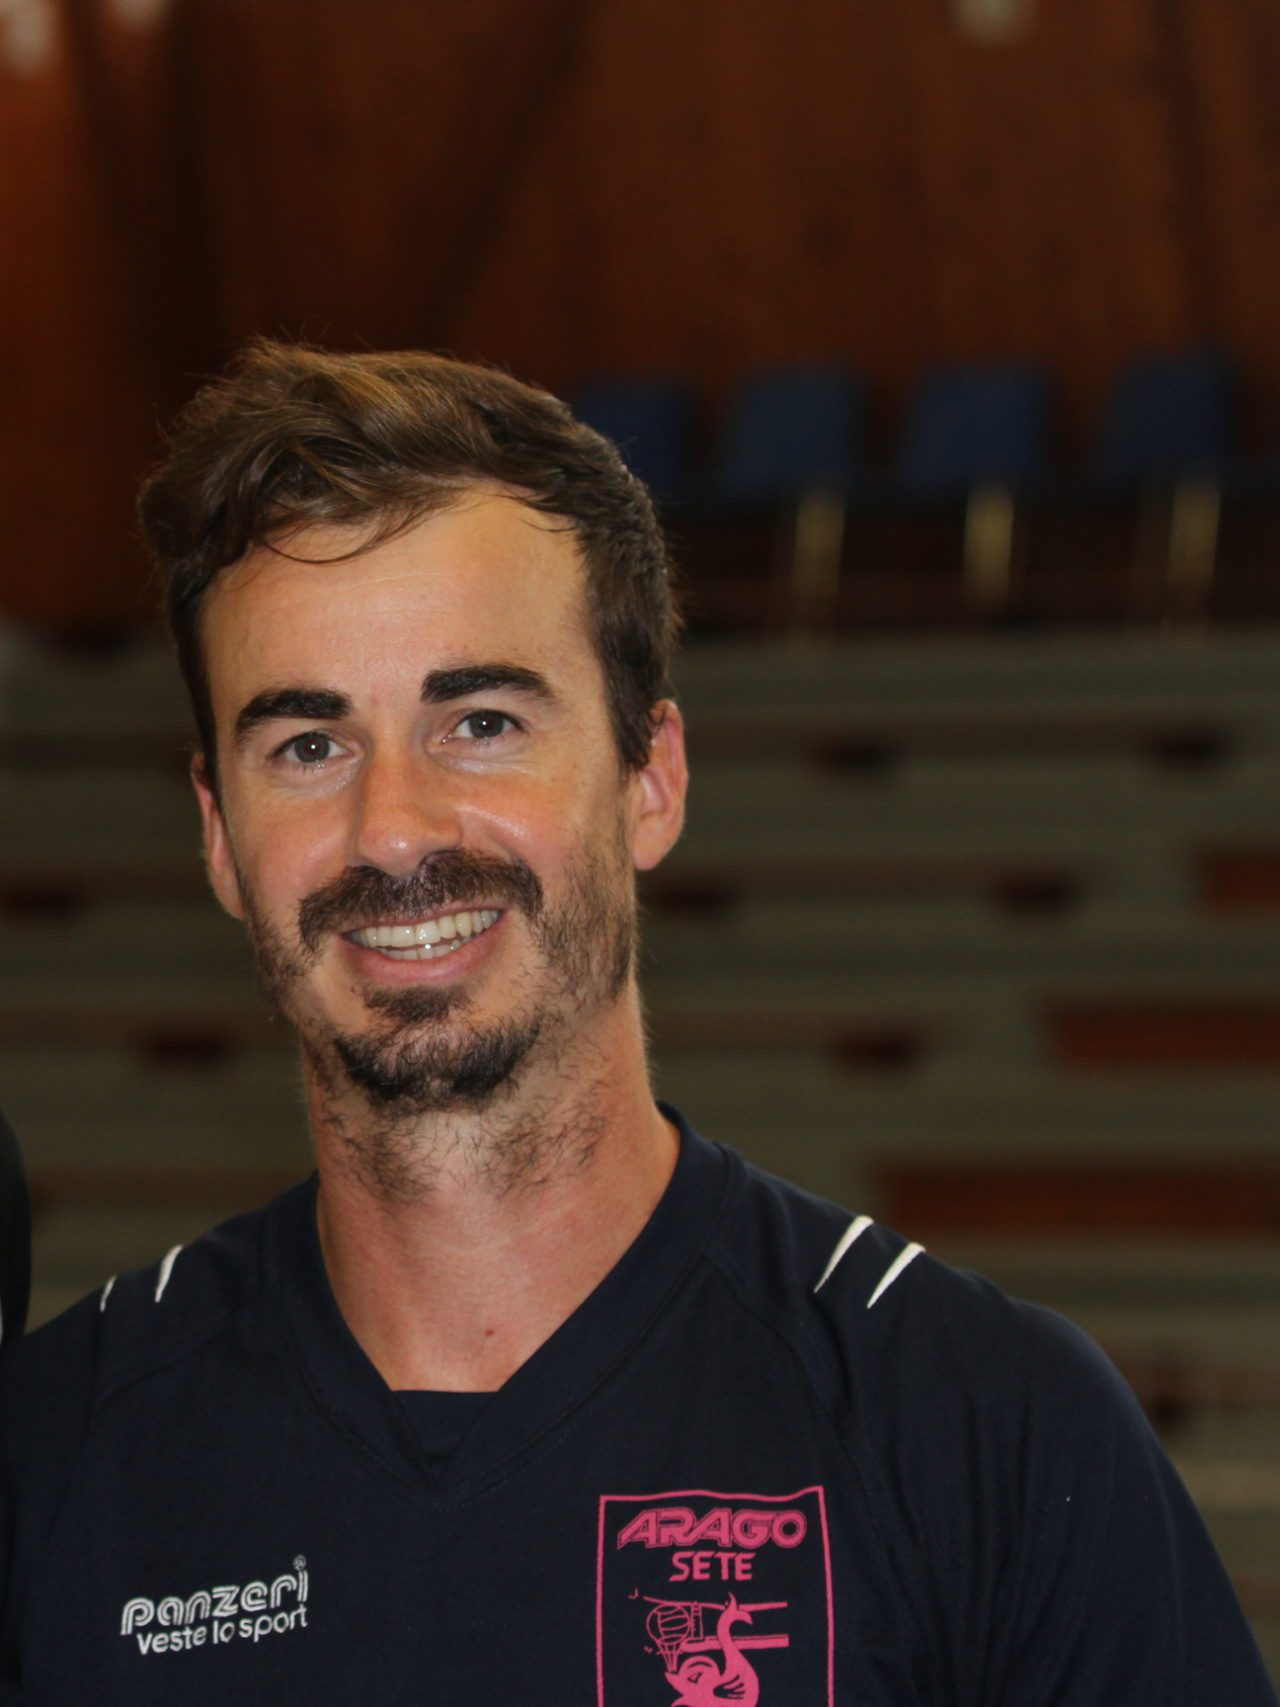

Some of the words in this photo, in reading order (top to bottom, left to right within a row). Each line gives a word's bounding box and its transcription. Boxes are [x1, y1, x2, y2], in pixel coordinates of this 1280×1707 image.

[617, 1506, 808, 1550] ARAGO
[669, 1551, 756, 1582] SETE
[120, 1554, 308, 1635] panzeri
[136, 1625, 207, 1655] veste
[213, 1620, 235, 1644] lo
[239, 1604, 308, 1643] sport
